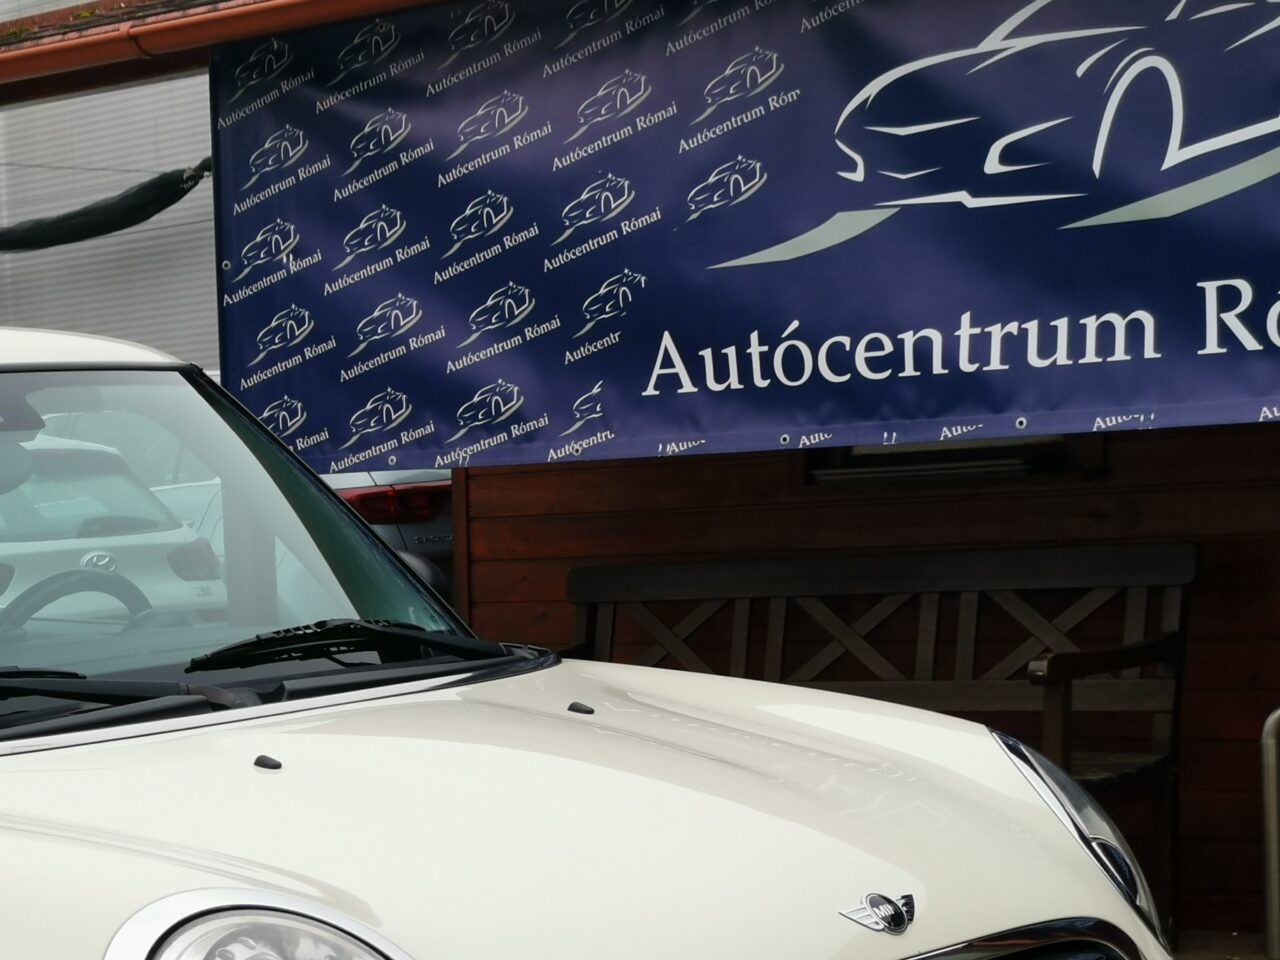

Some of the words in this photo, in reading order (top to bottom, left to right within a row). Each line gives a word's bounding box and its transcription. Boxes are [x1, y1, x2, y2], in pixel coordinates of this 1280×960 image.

[426, 54, 501, 97] Autócentrum
[503, 27, 542, 57] Római
[542, 29, 622, 79] Autócentrum
[624, 6, 665, 34] Római
[666, 6, 751, 56] Autócentrum
[217, 89, 280, 130] Autócentrum
[281, 66, 315, 93] Római
[315, 71, 387, 114] Autócentrum
[389, 49, 425, 76] Római
[437, 143, 510, 188] Autócentrum
[513, 120, 552, 150] Római
[552, 124, 632, 172] Autócentrum
[636, 100, 678, 129] Római
[678, 105, 765, 154] Autócentrum
[233, 175, 296, 216] Autócentrum
[298, 154, 331, 182] Római
[333, 160, 399, 202] Autócentrum
[400, 138, 435, 166] Római
[323, 256, 394, 296] Autócentrum
[395, 236, 431, 262] Római
[433, 242, 503, 285] Autócentrum
[503, 222, 539, 250] Római
[543, 228, 618, 273] Autócentrum
[620, 206, 662, 236] Római
[222, 268, 287, 307] Autócentrum
[239, 353, 303, 391] Autócentrum
[303, 335, 337, 361] Római
[339, 346, 407, 383] Autócentrum
[408, 325, 446, 351] Római
[446, 335, 523, 374] Autócentrum
[524, 314, 561, 341] Római
[641, 307, 1162, 397] Autócentrum
[296, 427, 330, 451] Római
[329, 437, 399, 474] Autócentrum
[400, 420, 436, 446] Római
[510, 412, 549, 439] Római
